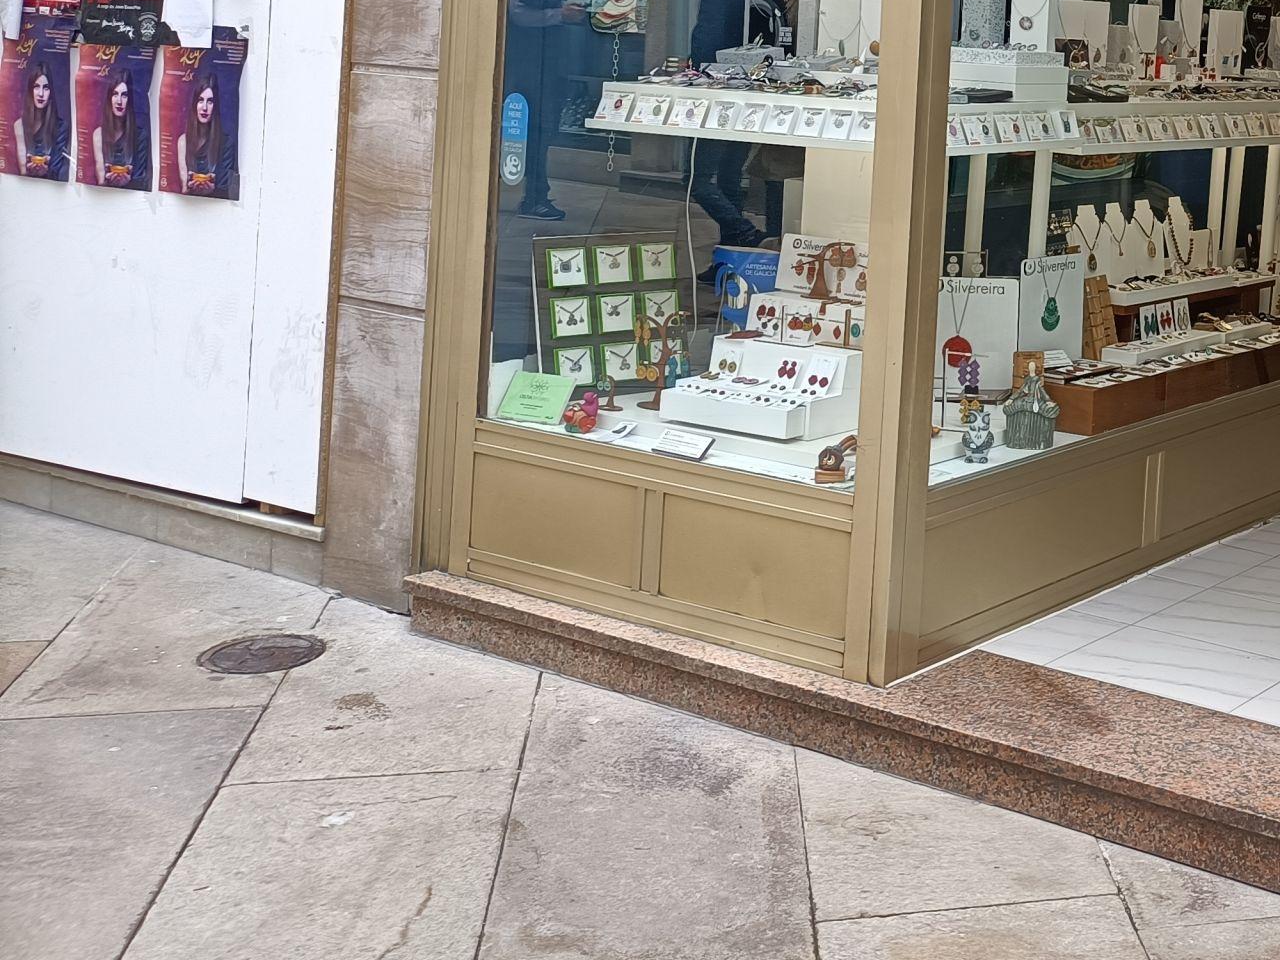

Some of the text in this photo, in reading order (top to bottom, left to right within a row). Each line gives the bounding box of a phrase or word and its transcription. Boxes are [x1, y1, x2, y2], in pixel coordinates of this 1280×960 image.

[802, 239, 824, 252] Silver
[1037, 260, 1076, 273] Silvereira
[946, 279, 1005, 295] Silvereira
